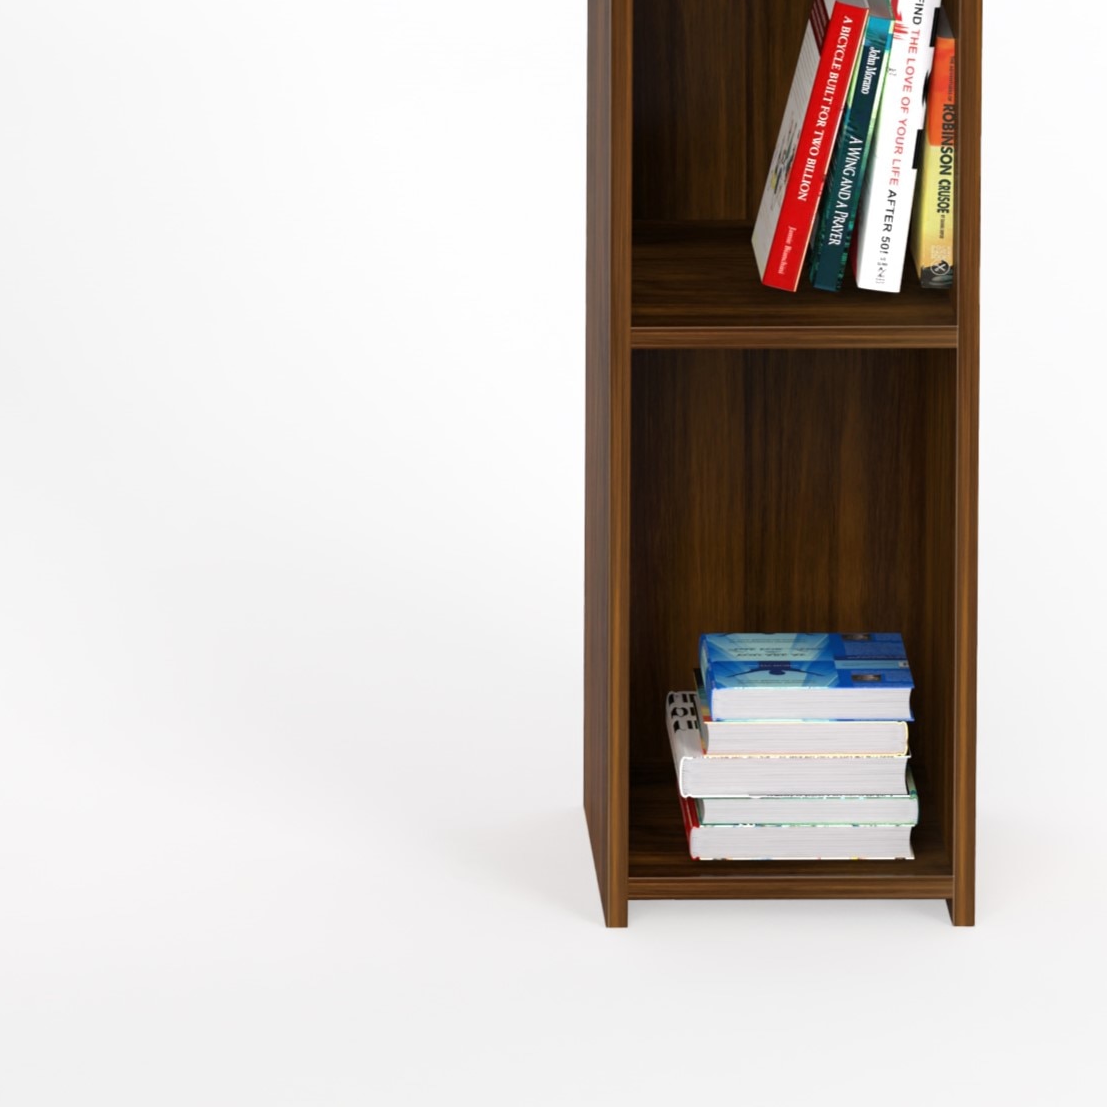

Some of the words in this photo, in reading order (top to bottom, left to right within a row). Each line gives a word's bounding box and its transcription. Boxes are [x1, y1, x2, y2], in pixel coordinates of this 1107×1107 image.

[842, 15, 853, 24] A
[831, 25, 852, 70] BICYCLE
[908, 29, 921, 54] THE
[867, 46, 881, 66] John
[822, 71, 839, 105] BUILT
[902, 58, 915, 93] LOVE
[816, 105, 831, 127] FOR
[900, 96, 911, 114] OF
[808, 130, 825, 156] TWO
[848, 135, 863, 144] A
[894, 118, 907, 155] YOUR
[939, 103, 955, 175] ROBINSON
[842, 147, 863, 176] WING
[889, 158, 901, 185] LIFE
[797, 158, 816, 202] BILLION
[837, 177, 854, 200] AND
[835, 200, 848, 208] A
[937, 179, 952, 214] CRUSOE
[882, 189, 897, 233] AFTER
[828, 210, 849, 246] PRAYER
[879, 236, 891, 254] 50!
